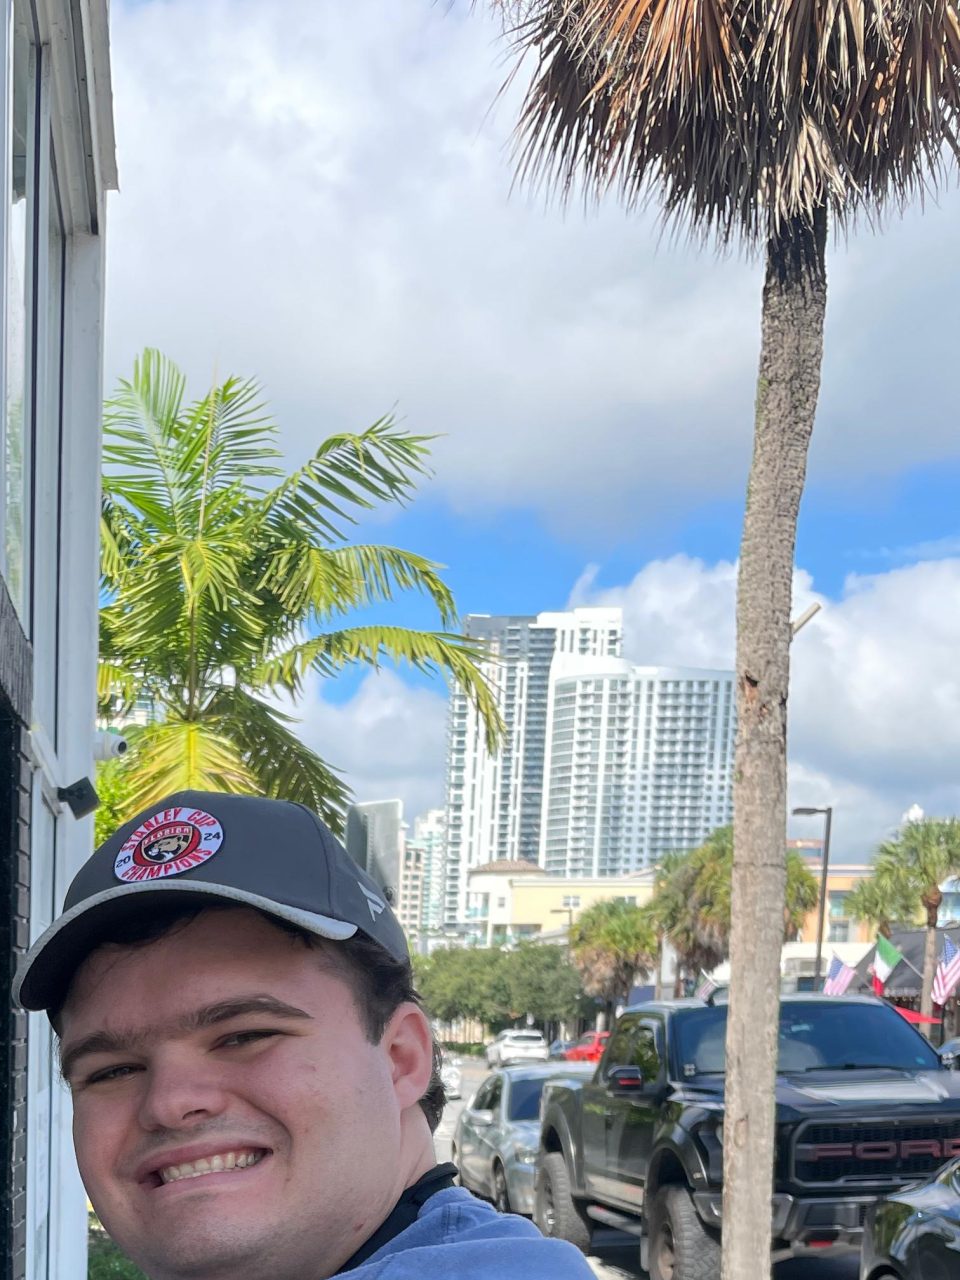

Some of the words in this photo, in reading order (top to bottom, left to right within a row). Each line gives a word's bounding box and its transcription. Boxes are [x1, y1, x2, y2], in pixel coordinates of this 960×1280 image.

[121, 807, 182, 853] STANLEY
[187, 810, 217, 828] CUP
[143, 826, 191, 847] FLORIDA
[203, 831, 221, 841] 24
[115, 855, 132, 869] 20
[120, 848, 213, 881] CHAMPIONS
